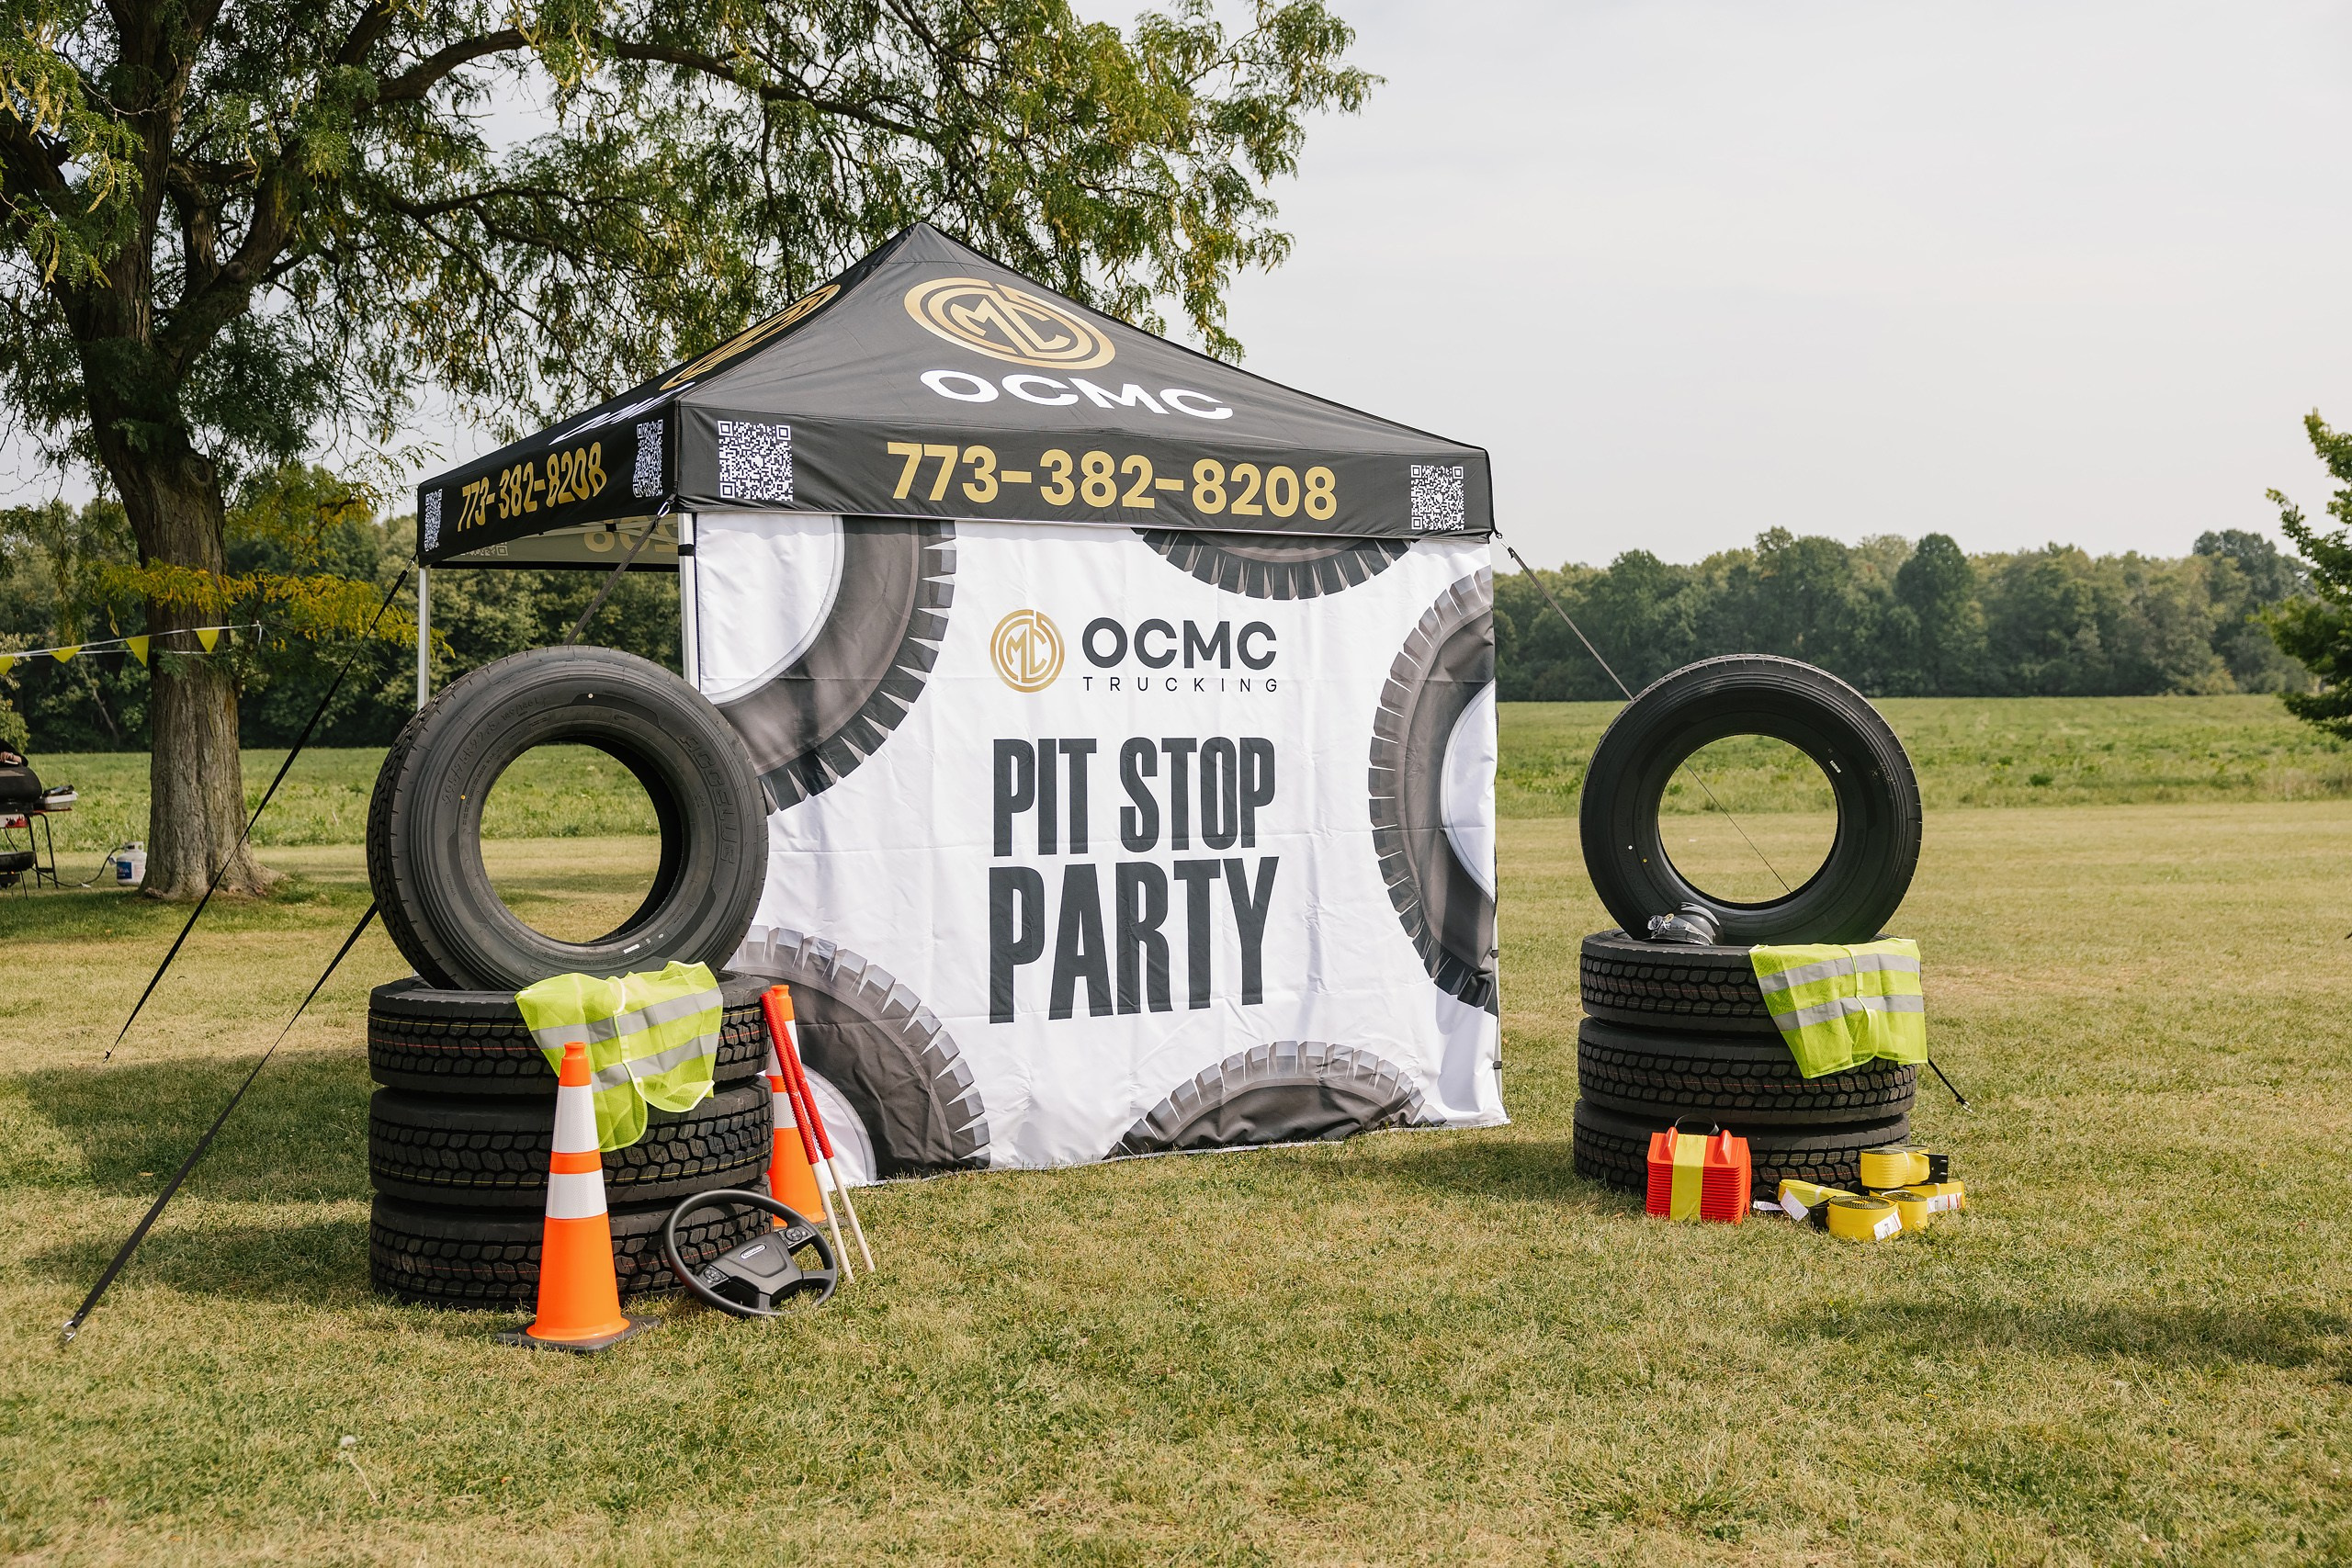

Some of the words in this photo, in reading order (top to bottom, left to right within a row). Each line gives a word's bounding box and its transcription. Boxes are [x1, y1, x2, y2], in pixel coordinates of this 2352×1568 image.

[919, 369, 1234, 421] OCMC
[457, 441, 607, 533] 773-382-8208
[887, 441, 1338, 521] 773-382-8208
[1081, 616, 1277, 671] OCMC
[1082, 676, 1277, 693] TRUCKING
[993, 738, 1097, 857] PIT
[1119, 737, 1275, 852] STOP
[989, 856, 1280, 1024] PARTY
